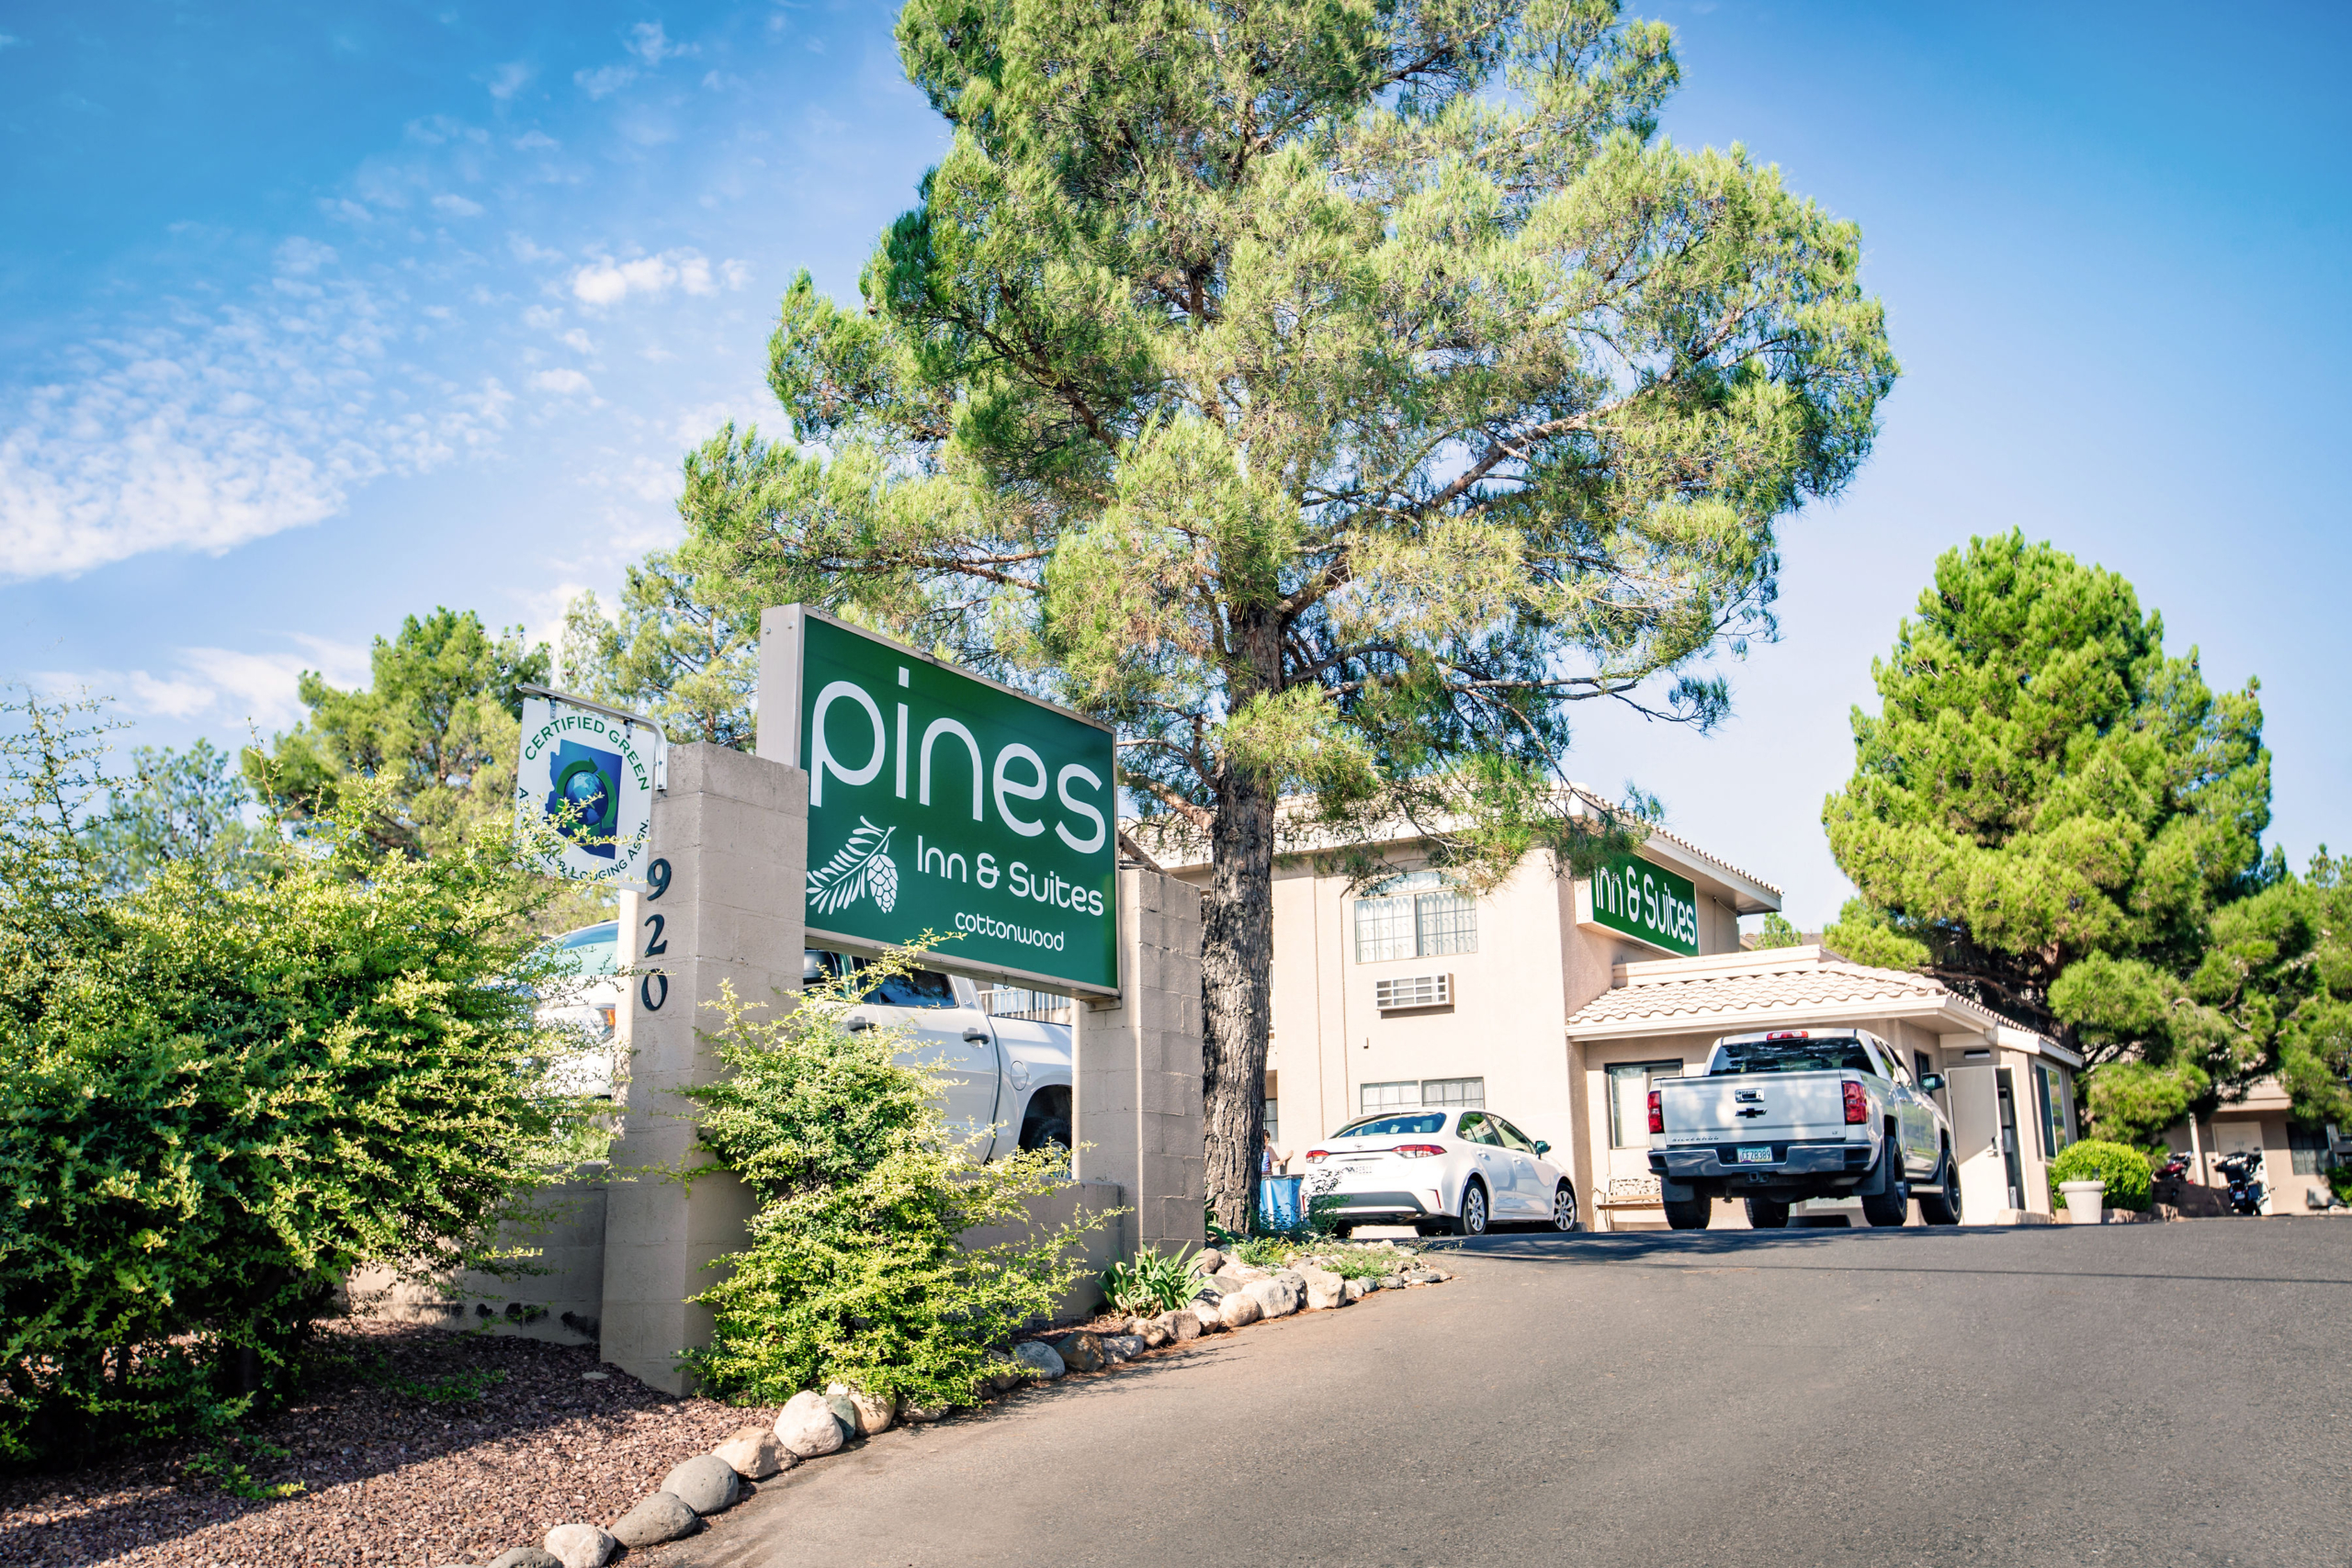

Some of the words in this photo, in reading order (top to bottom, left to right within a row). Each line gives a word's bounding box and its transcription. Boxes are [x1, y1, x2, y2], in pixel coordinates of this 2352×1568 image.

[525, 716, 605, 761] CERTIFIED
[608, 729, 650, 791] GREEN
[810, 666, 1106, 854] pines
[917, 835, 967, 884] Inn
[977, 852, 1001, 889] &
[1009, 861, 1104, 917] Suites
[1594, 865, 1624, 918] Inn
[1625, 865, 1641, 923] &
[1643, 873, 1696, 946] Suites
[641, 857, 673, 1011] 920
[955, 911, 1065, 952] cottonwood
